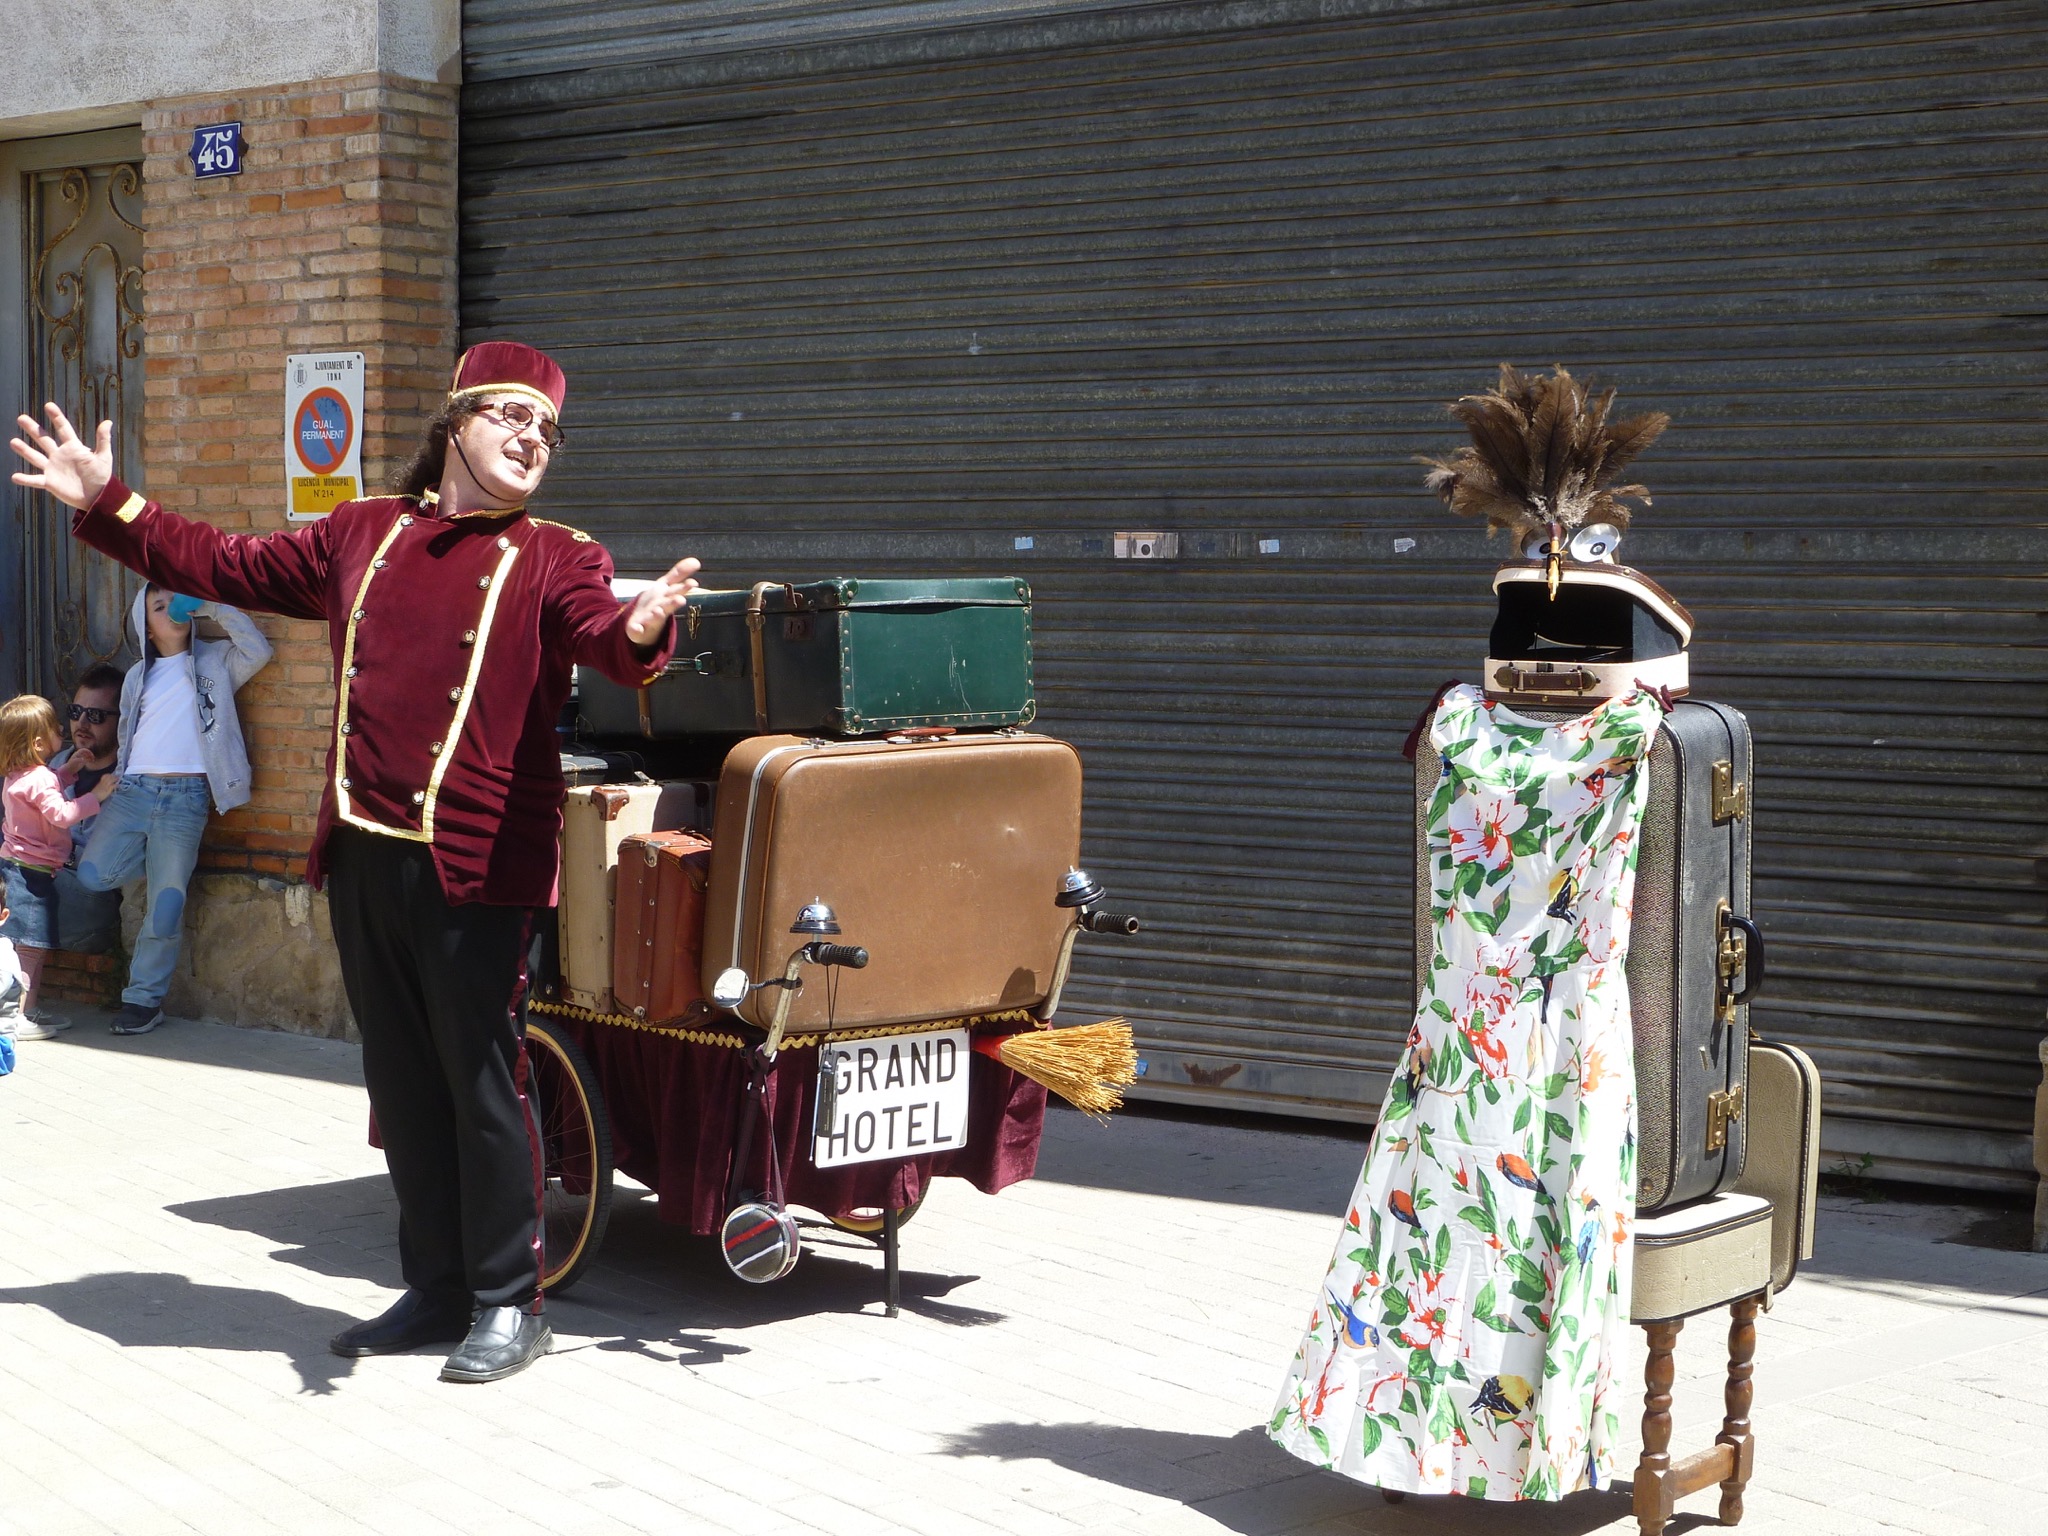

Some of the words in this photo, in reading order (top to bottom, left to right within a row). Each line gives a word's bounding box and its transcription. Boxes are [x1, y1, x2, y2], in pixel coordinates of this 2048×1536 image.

[197, 129, 235, 171] 45
[314, 360, 345, 371] AJUNTAMENT
[346, 359, 354, 370] DE
[326, 372, 342, 381] TONA
[312, 419, 334, 430] GUAL
[302, 429, 344, 440] PERMANENT
[323, 477, 350, 487] MUNICIPAL
[321, 489, 335, 498] 214
[196, 674, 215, 691] TIC
[837, 1037, 957, 1096] GRAND
[827, 1100, 953, 1160] HOTEL
